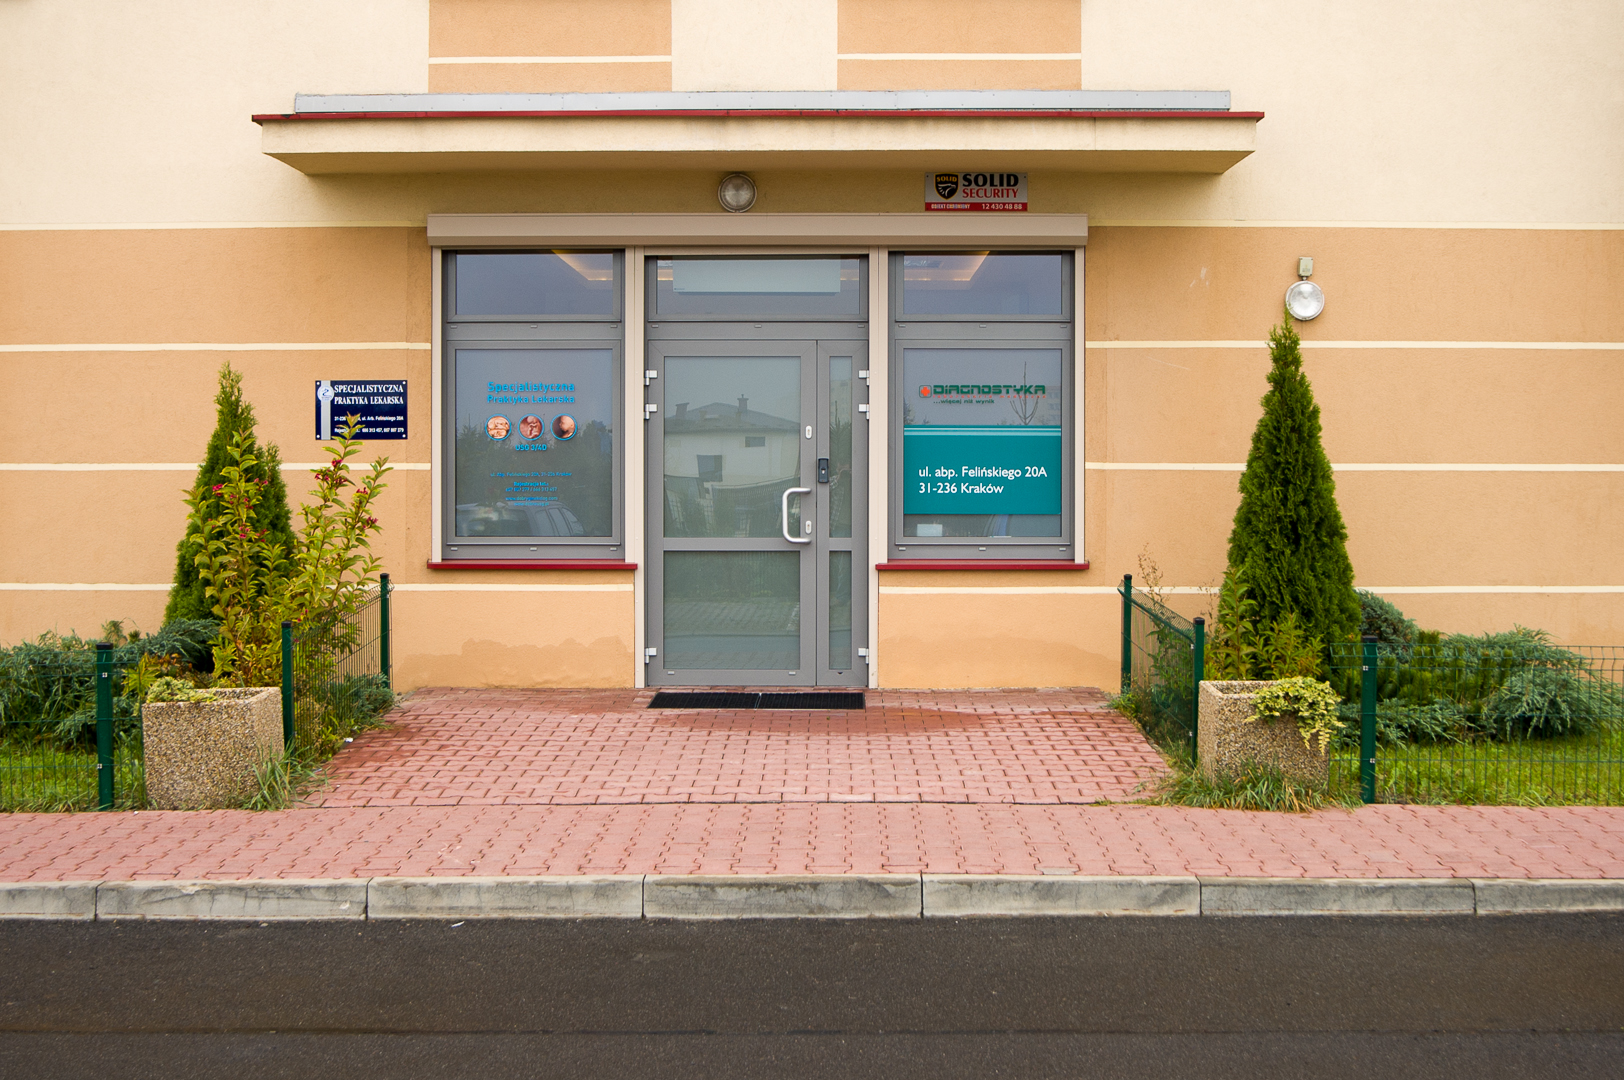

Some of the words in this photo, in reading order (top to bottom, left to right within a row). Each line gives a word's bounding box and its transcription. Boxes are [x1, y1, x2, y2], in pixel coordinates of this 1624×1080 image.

[962, 173, 1019, 187] SOLID
[962, 187, 1019, 198] SECURITY
[334, 384, 404, 393] SPECJALISTYCZNA
[487, 381, 575, 394] Specjalistyczna
[334, 396, 368, 405] PRAKTYKA
[370, 396, 404, 405] LEKARSKA
[486, 394, 529, 405] Praktyka
[531, 394, 575, 403] Lekarska
[515, 443, 530, 451] USG
[530, 443, 547, 451] 3/4D
[918, 466, 932, 477] ul.
[934, 466, 958, 480] abp.
[961, 466, 1022, 480] Felińskiego
[1024, 466, 1048, 477] 20A
[918, 482, 958, 494] 31-236
[960, 482, 1004, 494] Kraków
